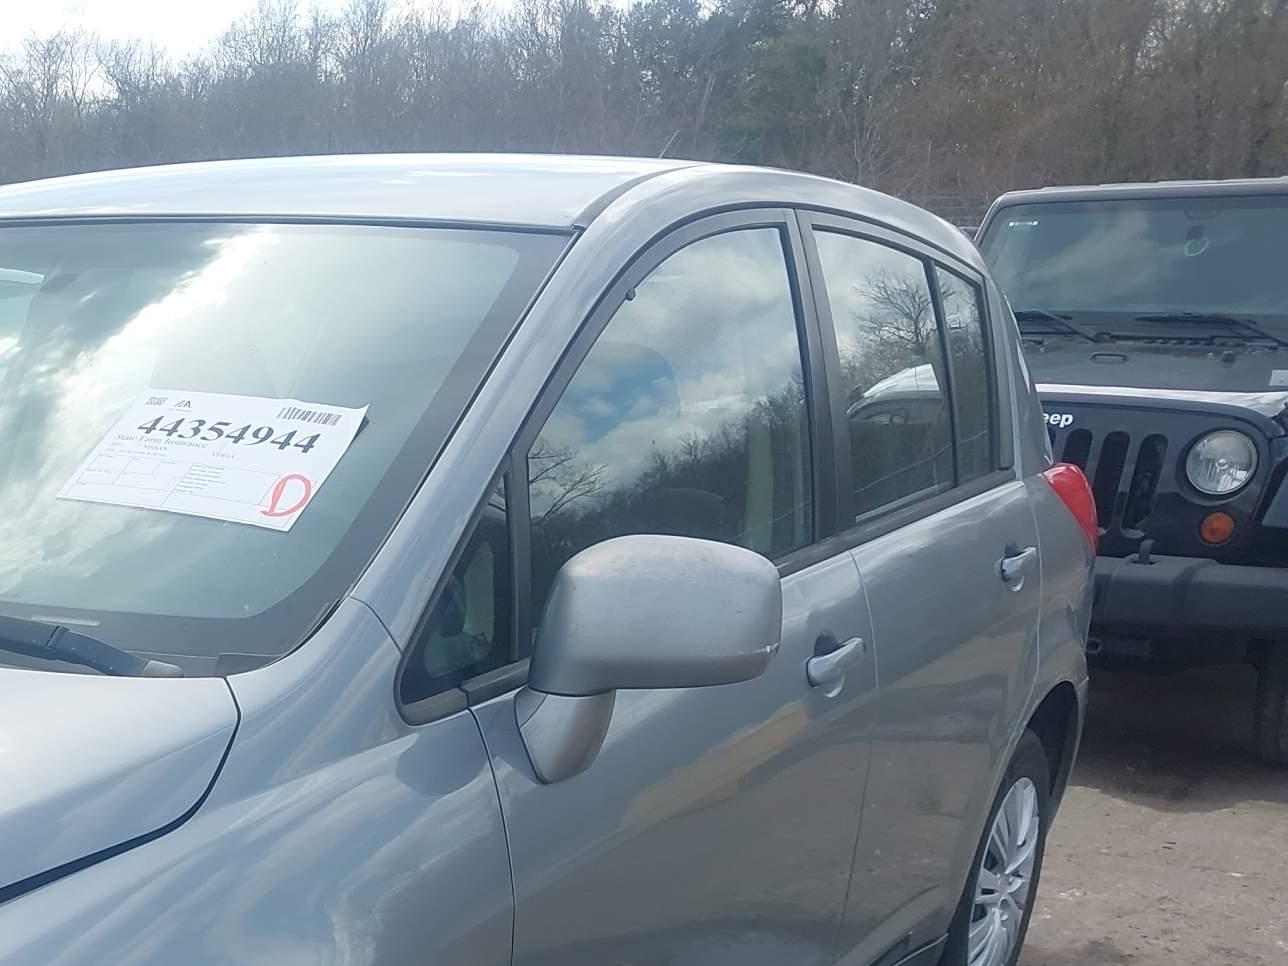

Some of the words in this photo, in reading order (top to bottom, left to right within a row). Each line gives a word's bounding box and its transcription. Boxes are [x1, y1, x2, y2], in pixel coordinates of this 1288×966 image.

[1042, 413, 1073, 428] eep
[114, 432, 138, 442] State
[139, 434, 162, 445] Farm
[164, 436, 209, 449] Insurance
[137, 415, 322, 455] 44354944
[261, 473, 312, 517] D
